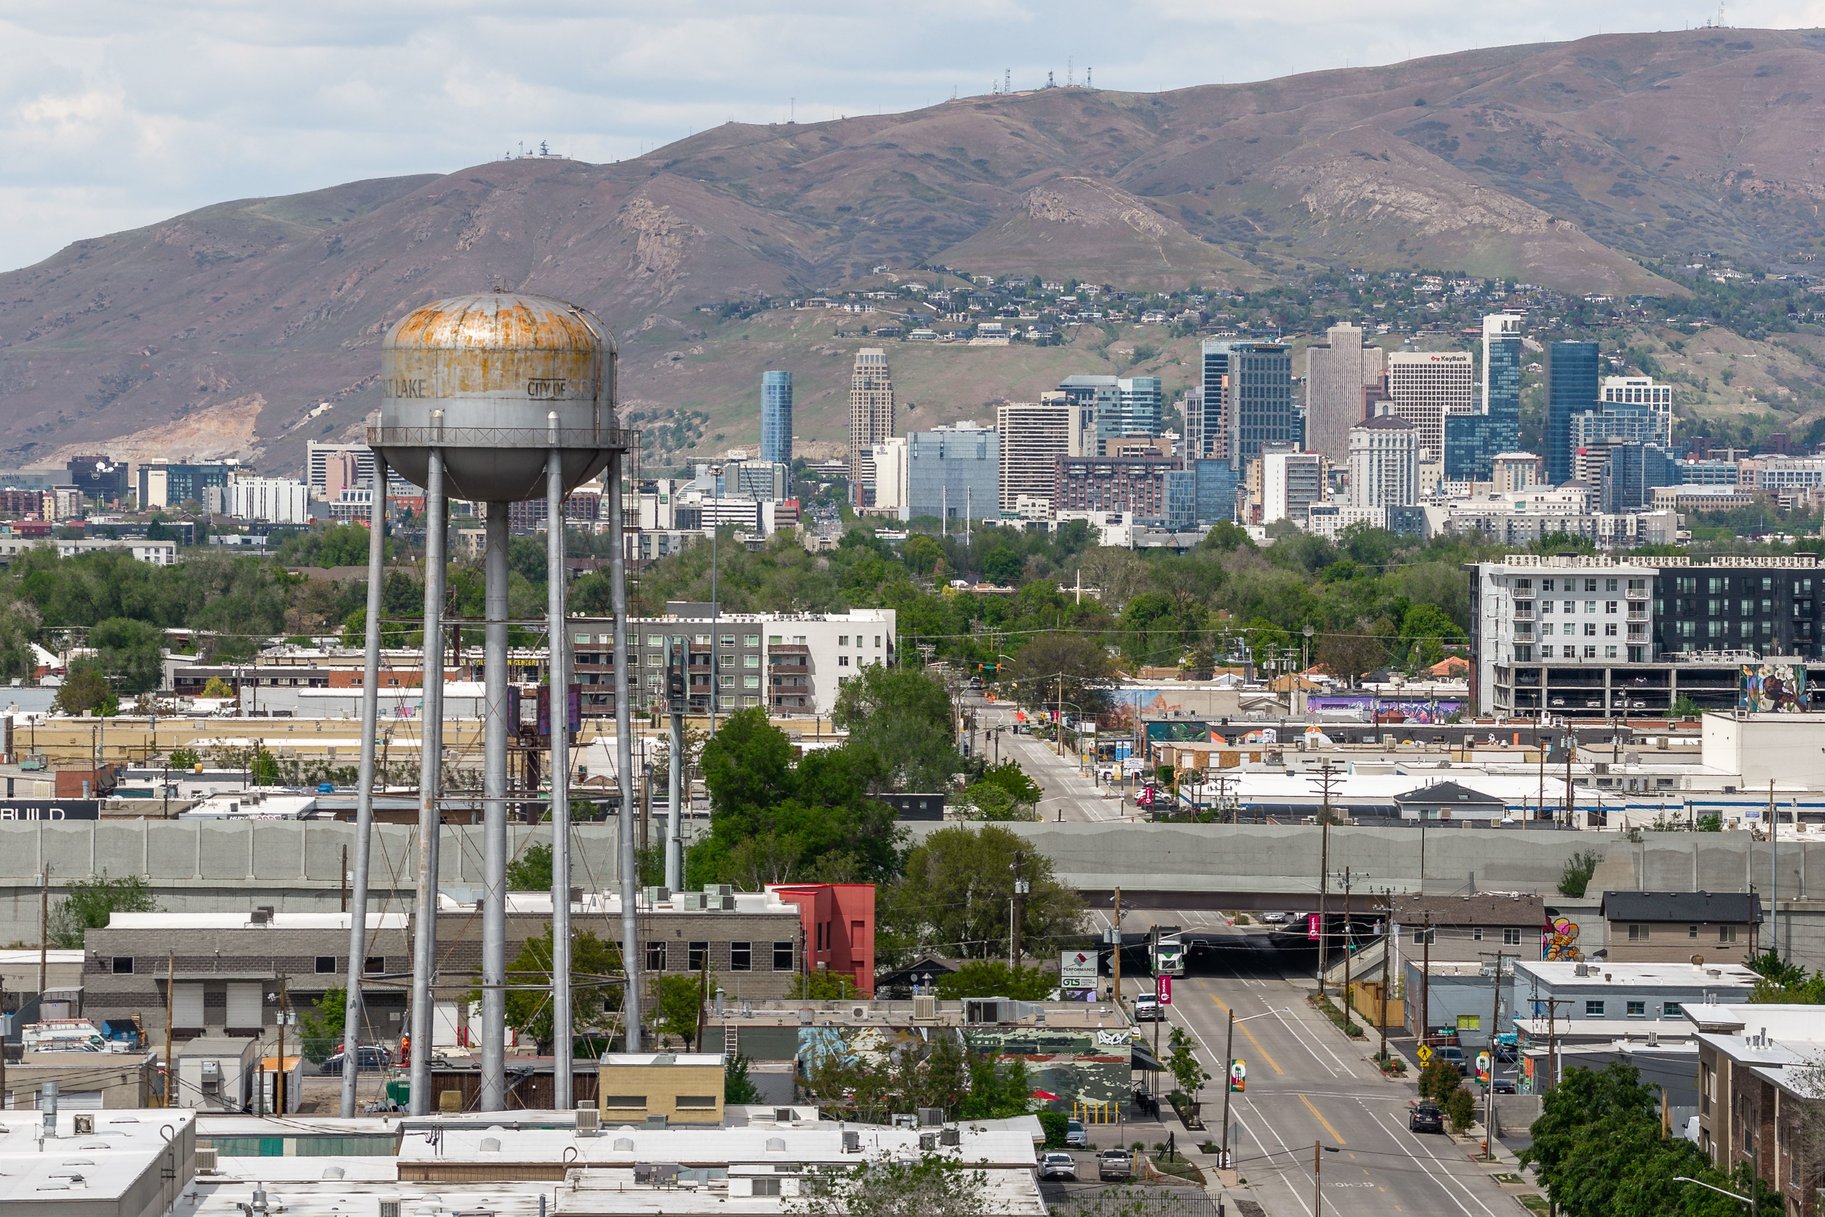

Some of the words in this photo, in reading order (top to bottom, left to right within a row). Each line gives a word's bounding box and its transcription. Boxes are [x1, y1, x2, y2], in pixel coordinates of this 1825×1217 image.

[395, 379, 426, 398] LAKE
[527, 381, 550, 396] CITY
[553, 382, 566, 396] OF
